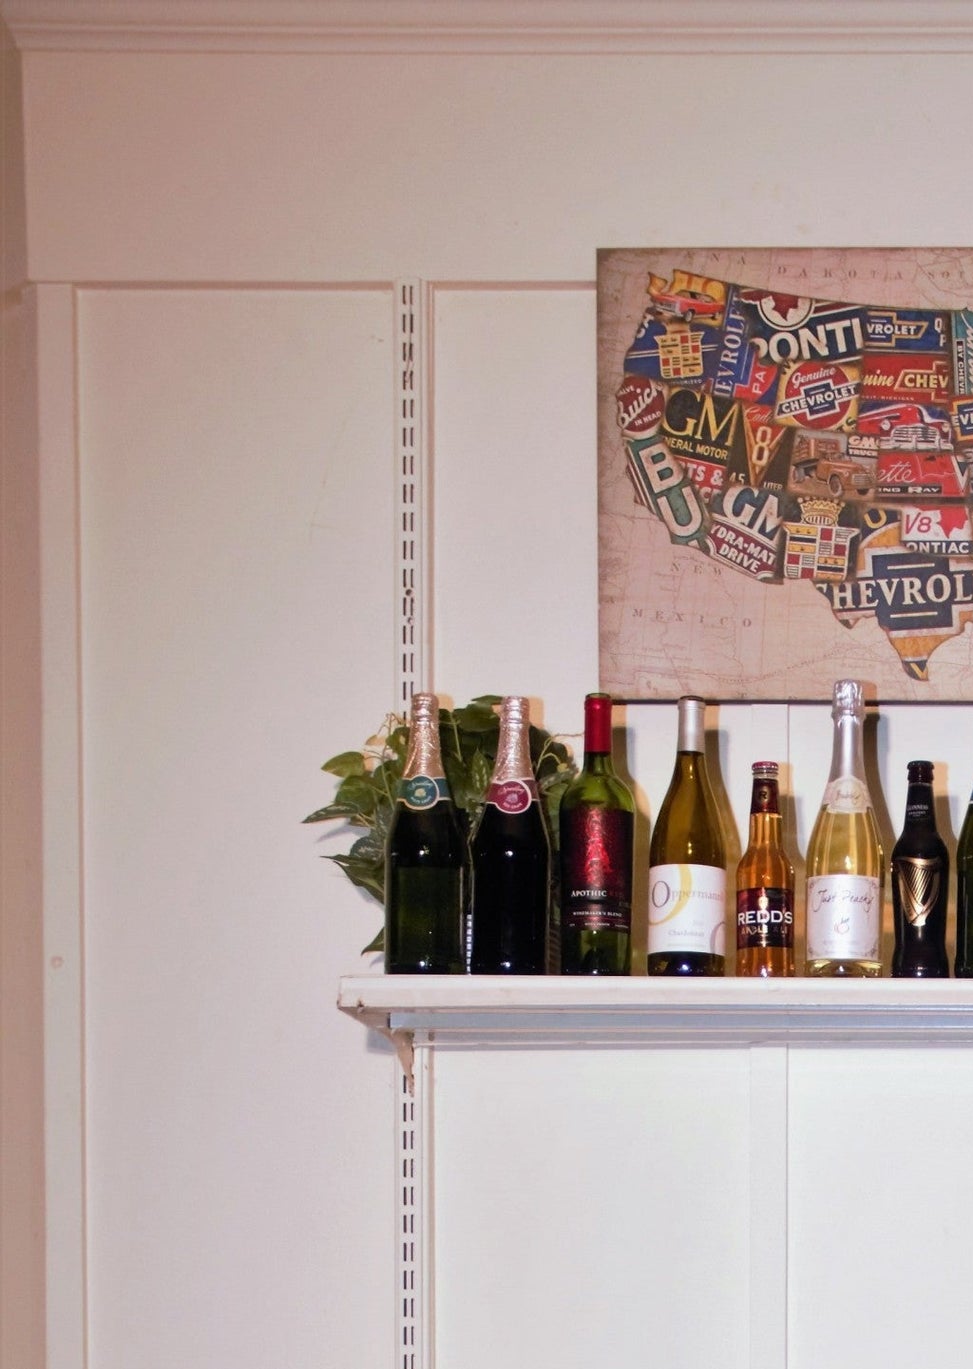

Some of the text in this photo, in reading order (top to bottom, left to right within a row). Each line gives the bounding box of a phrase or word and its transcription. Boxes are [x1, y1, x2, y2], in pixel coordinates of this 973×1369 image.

[791, 366, 837, 388] Genuine
[904, 373, 949, 388] CHEV
[781, 386, 857, 414] CHEVROLET
[661, 387, 741, 447] GM
[904, 513, 932, 535] V8
[718, 543, 761, 573] DRIVE
[571, 890, 607, 898] APOTHIC
